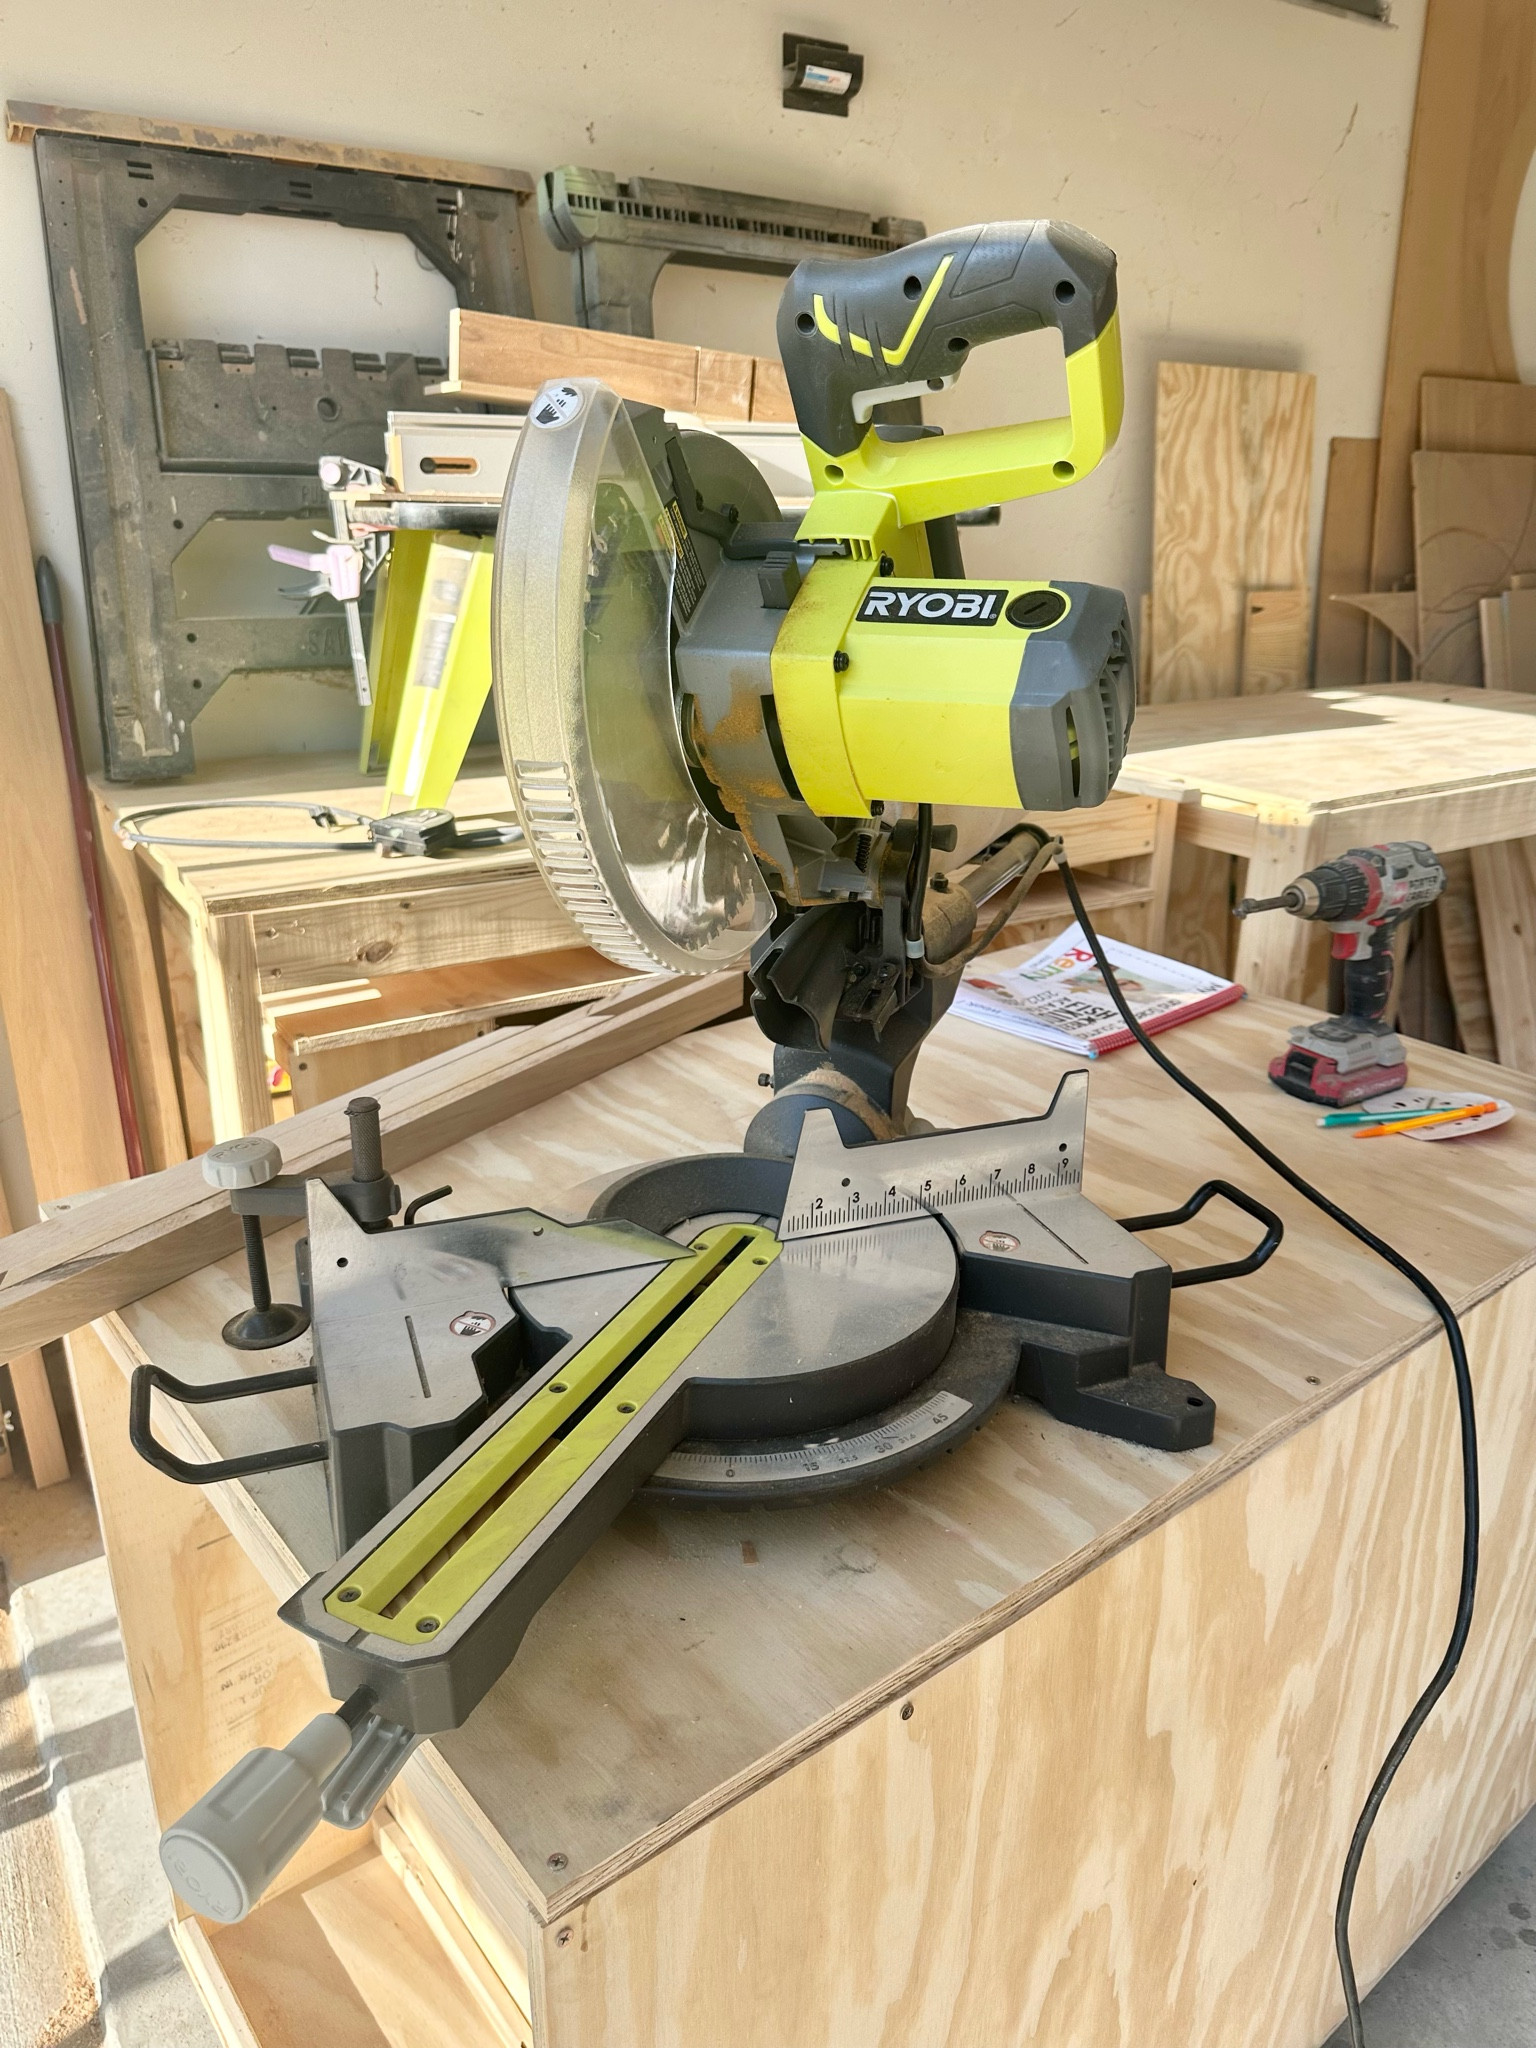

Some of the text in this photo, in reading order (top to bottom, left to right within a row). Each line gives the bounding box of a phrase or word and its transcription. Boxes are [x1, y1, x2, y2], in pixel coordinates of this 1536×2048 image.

[863, 591, 997, 620] RYOBI
[1021, 946, 1095, 983] Remy
[1064, 1000, 1120, 1020] FISH
[815, 1158, 1070, 1210] 2 3 4 5 6 7 8 9
[725, 1468, 736, 1478] 0
[802, 1461, 820, 1472] 15
[874, 1441, 894, 1454] 30
[932, 1413, 949, 1425] 45
